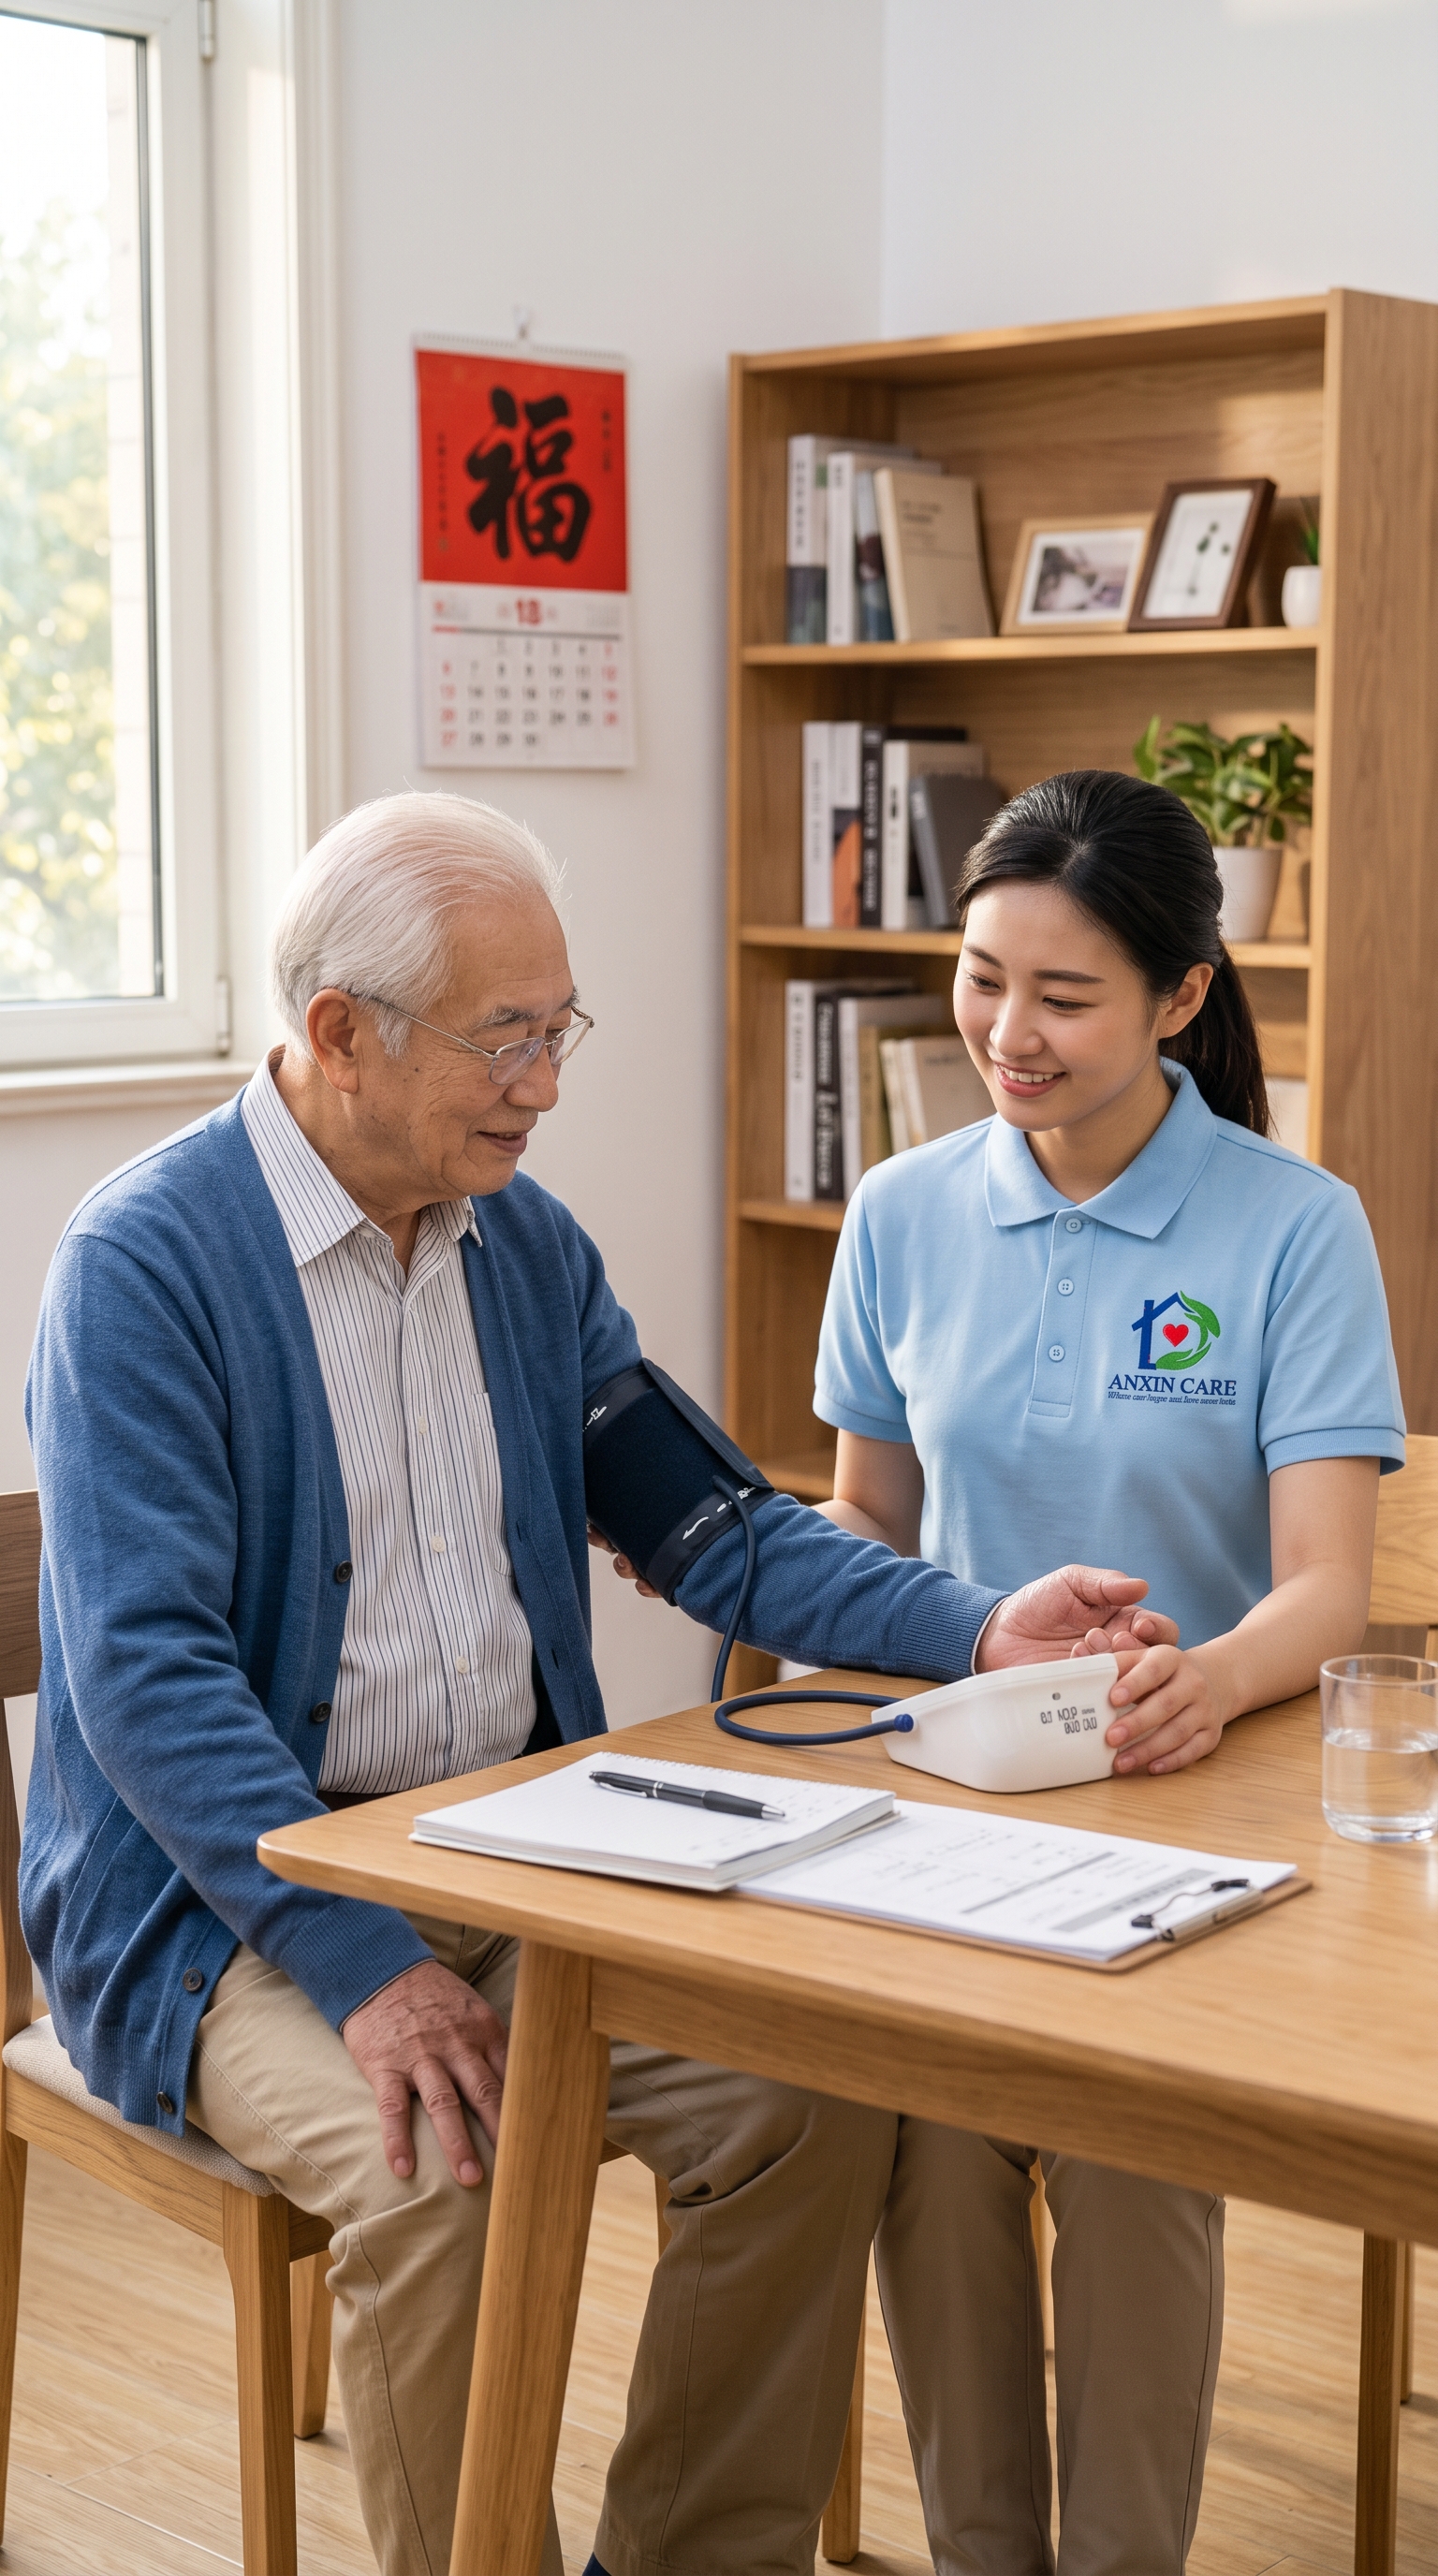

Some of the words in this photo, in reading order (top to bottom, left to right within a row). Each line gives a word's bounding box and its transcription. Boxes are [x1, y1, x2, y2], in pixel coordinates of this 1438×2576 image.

[465, 386, 593, 564] 福
[1108, 1374, 1176, 1394] ANXIN
[1180, 1378, 1237, 1397] CARE
